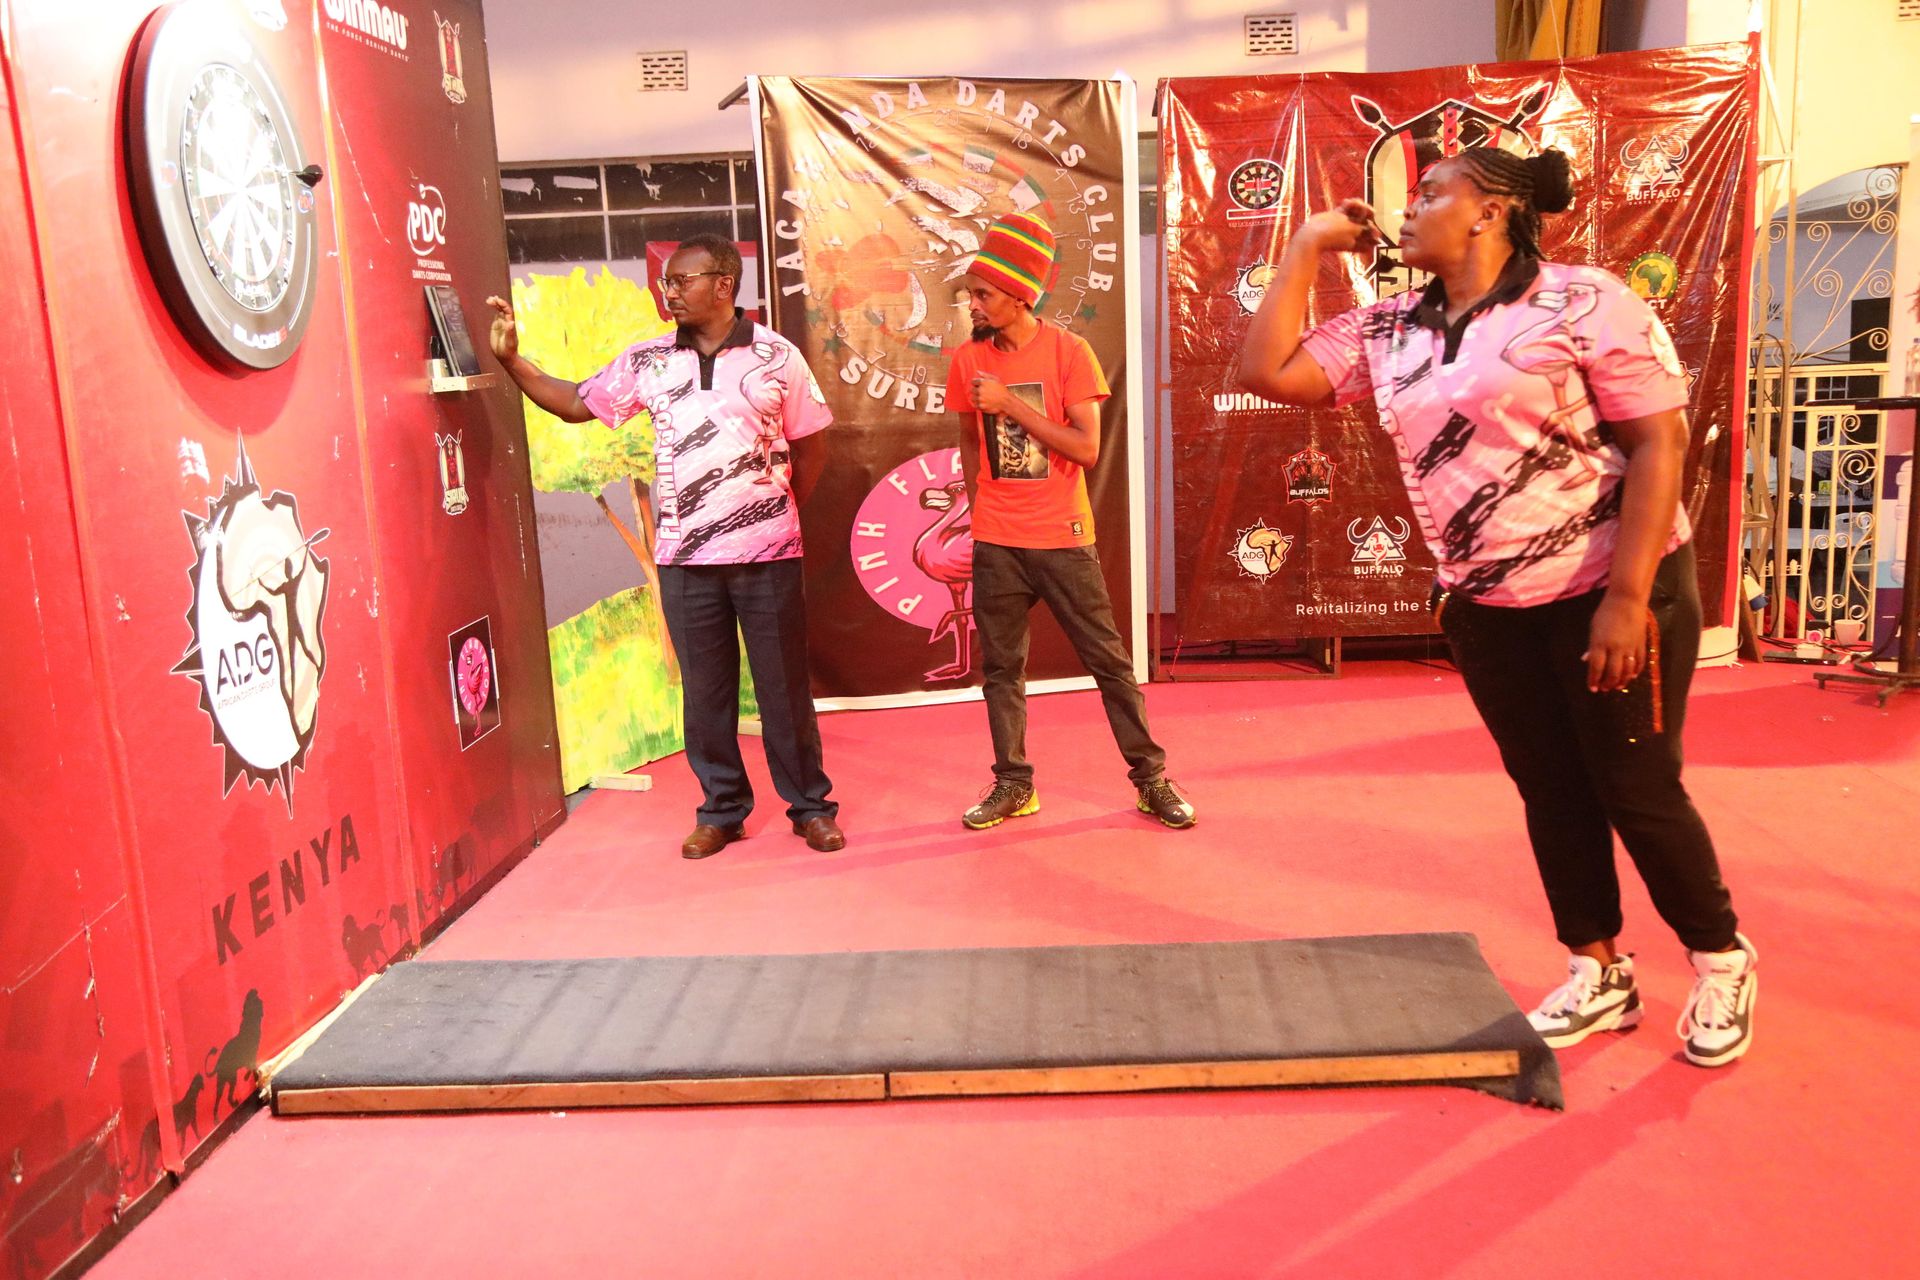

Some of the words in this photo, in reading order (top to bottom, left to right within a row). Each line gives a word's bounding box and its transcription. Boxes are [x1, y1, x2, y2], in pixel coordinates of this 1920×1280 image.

[957, 79, 1087, 168] DARTS
[1083, 184, 1117, 292] CLUB
[408, 201, 446, 246] PDC
[1647, 298, 1668, 311] CT
[840, 356, 947, 414] SURE
[645, 392, 682, 541] FLAMINGOS
[856, 521, 923, 616] PINK
[1241, 551, 1265, 560] ADG
[1353, 564, 1405, 576] BUFFALO
[1295, 601, 1388, 616] Revitalizing
[1393, 600, 1420, 612] the
[216, 632, 274, 695] ADG
[211, 813, 361, 966] KENYA
